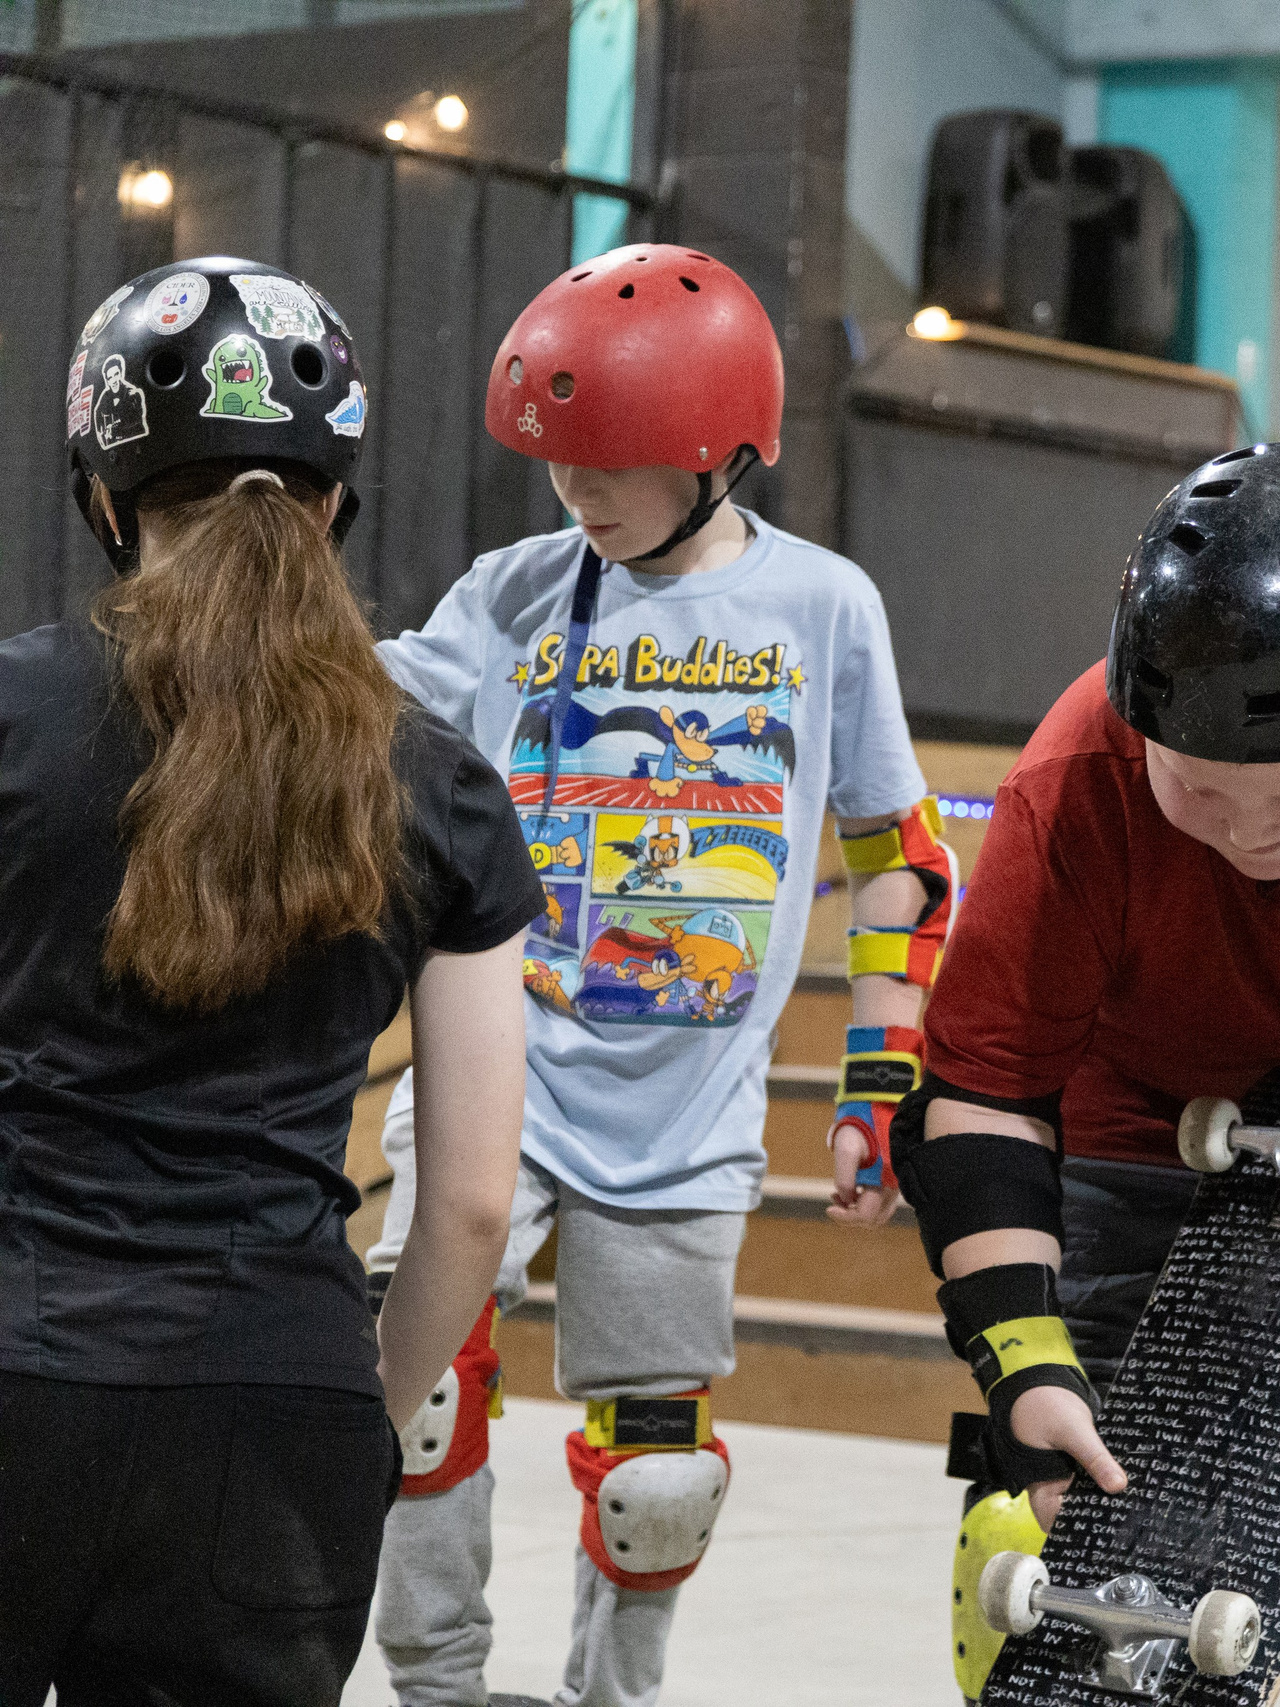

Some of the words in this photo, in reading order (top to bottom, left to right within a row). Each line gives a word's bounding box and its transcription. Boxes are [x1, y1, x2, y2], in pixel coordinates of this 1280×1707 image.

[529, 631, 620, 690] SPA
[625, 633, 788, 691] Buddies!
[534, 848, 544, 863] D
[1188, 1251, 1216, 1261] NOT
[1166, 1264, 1196, 1274] NOT
[1152, 1303, 1169, 1312] IN
[1161, 1330, 1188, 1342] NOT
[1178, 1362, 1192, 1371] IN
[1121, 1373, 1137, 1381] IN
[1165, 1402, 1181, 1412] IN
[1111, 1414, 1127, 1422] IN
[1135, 1443, 1163, 1452] NOT
[1110, 1512, 1127, 1522] IN
[1251, 1544, 1280, 1557] NOT
[1061, 1548, 1088, 1559] NOT
[1252, 1570, 1271, 1584] IN
[1043, 1632, 1062, 1645] IN
[1022, 1663, 1053, 1676] WILL
[1008, 1674, 1037, 1688] NOT
